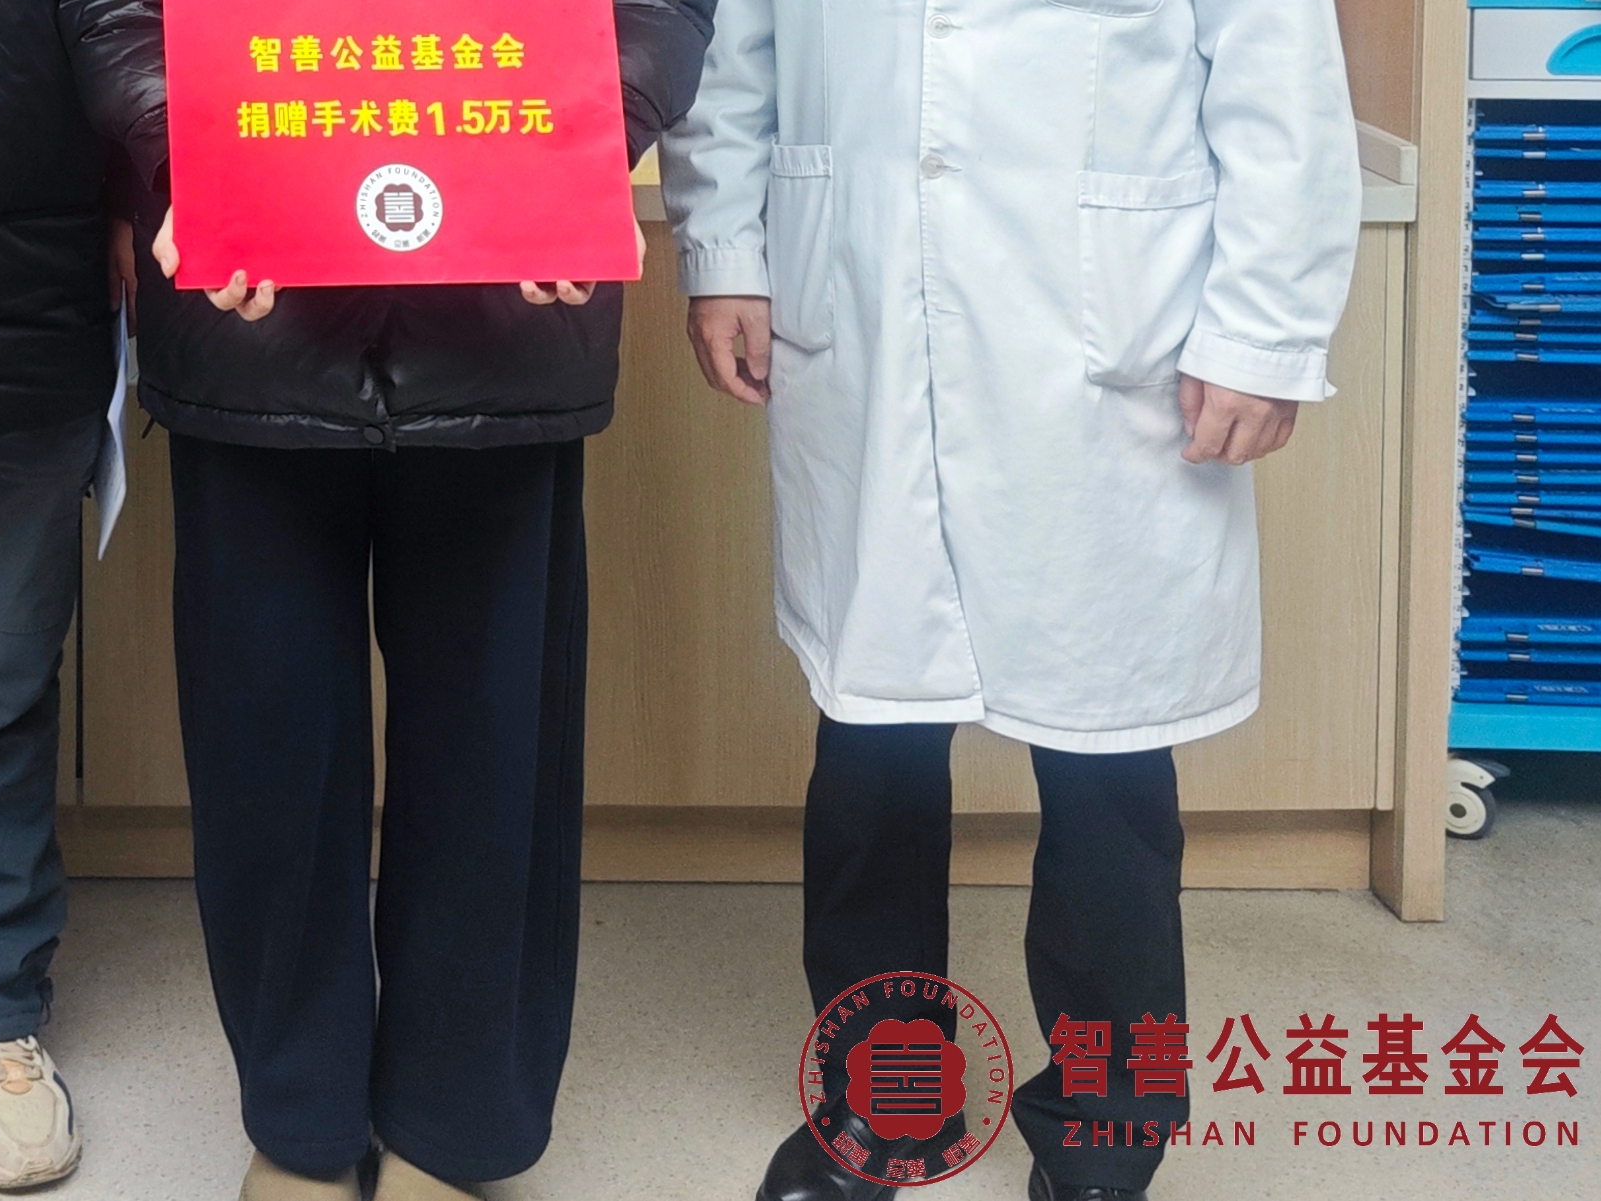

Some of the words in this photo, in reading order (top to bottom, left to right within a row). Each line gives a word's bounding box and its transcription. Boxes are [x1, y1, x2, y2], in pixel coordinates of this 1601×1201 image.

[249, 33, 525, 72] 智善公益基金会
[238, 99, 554, 139] 捐赠手术费1.5万元
[387, 167, 440, 218] FOUNDATION
